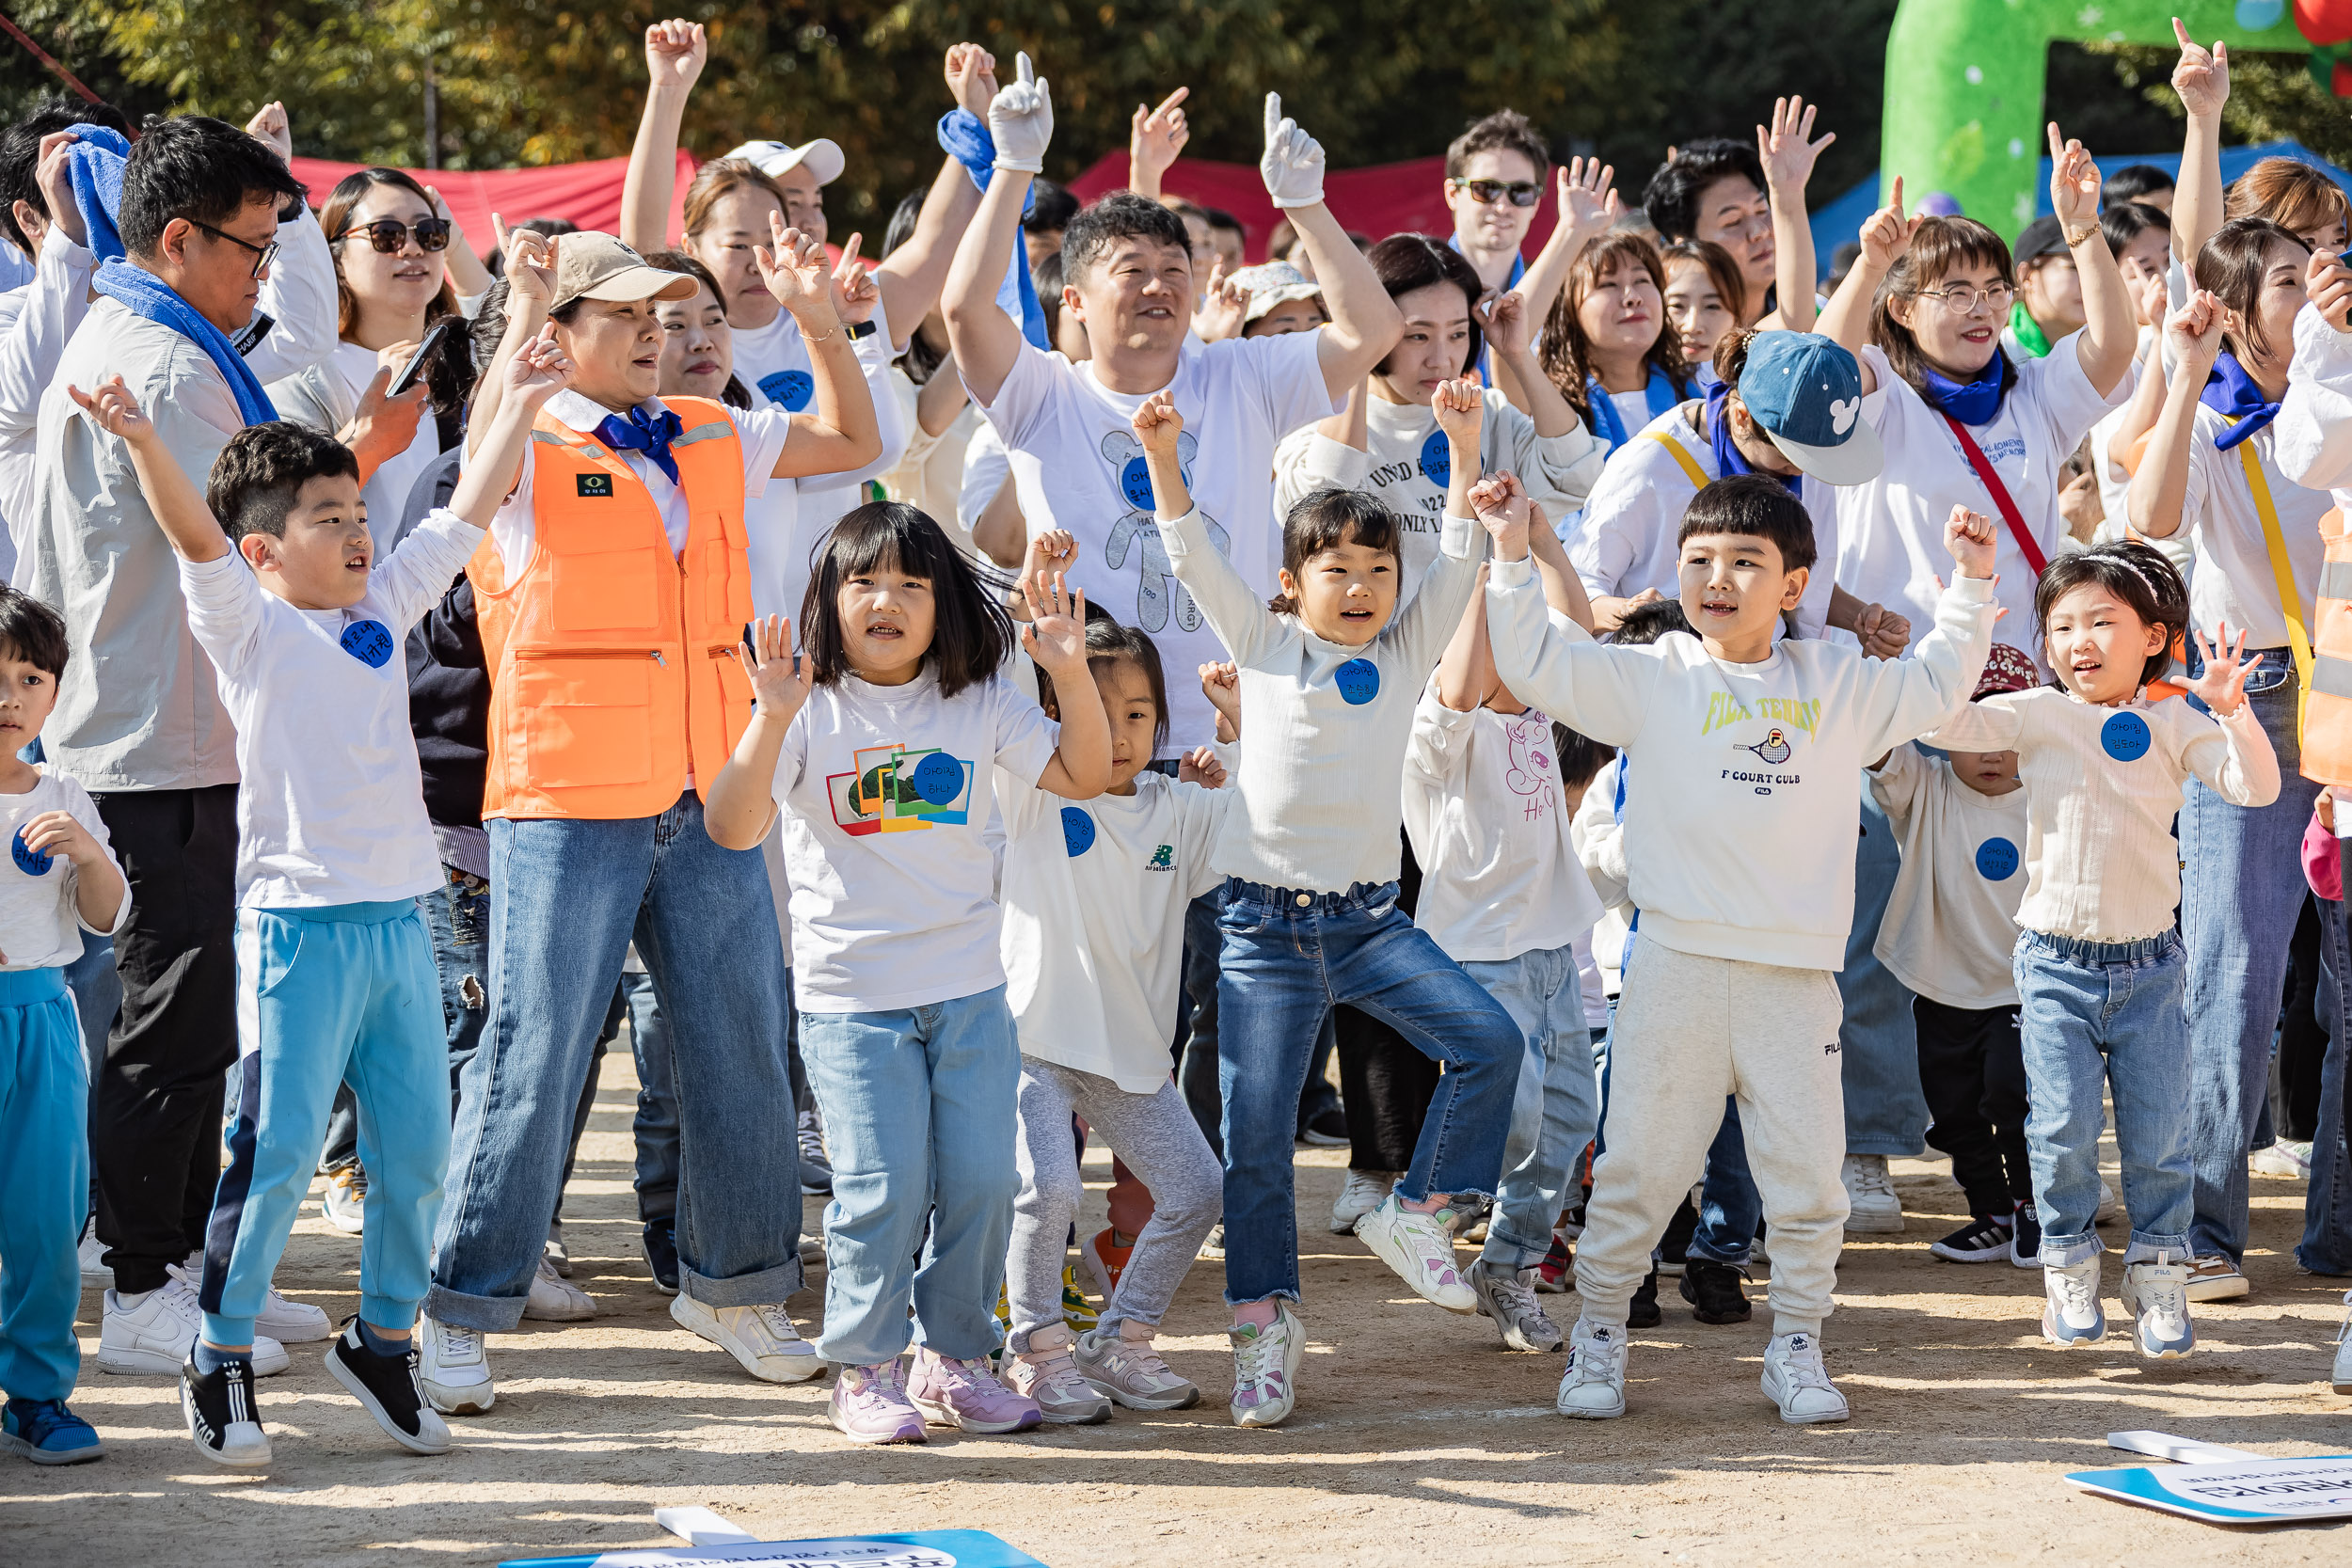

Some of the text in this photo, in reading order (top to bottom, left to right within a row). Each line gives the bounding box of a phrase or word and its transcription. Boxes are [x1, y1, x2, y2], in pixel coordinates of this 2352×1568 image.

[1142, 586, 1157, 599] TOO
[1346, 682, 1374, 698] 조승희
[1701, 691, 1753, 736] FILA
[2110, 738, 2141, 750] 김도아
[1722, 769, 1801, 784] F COURT CULB
[928, 783, 951, 794] 하나
